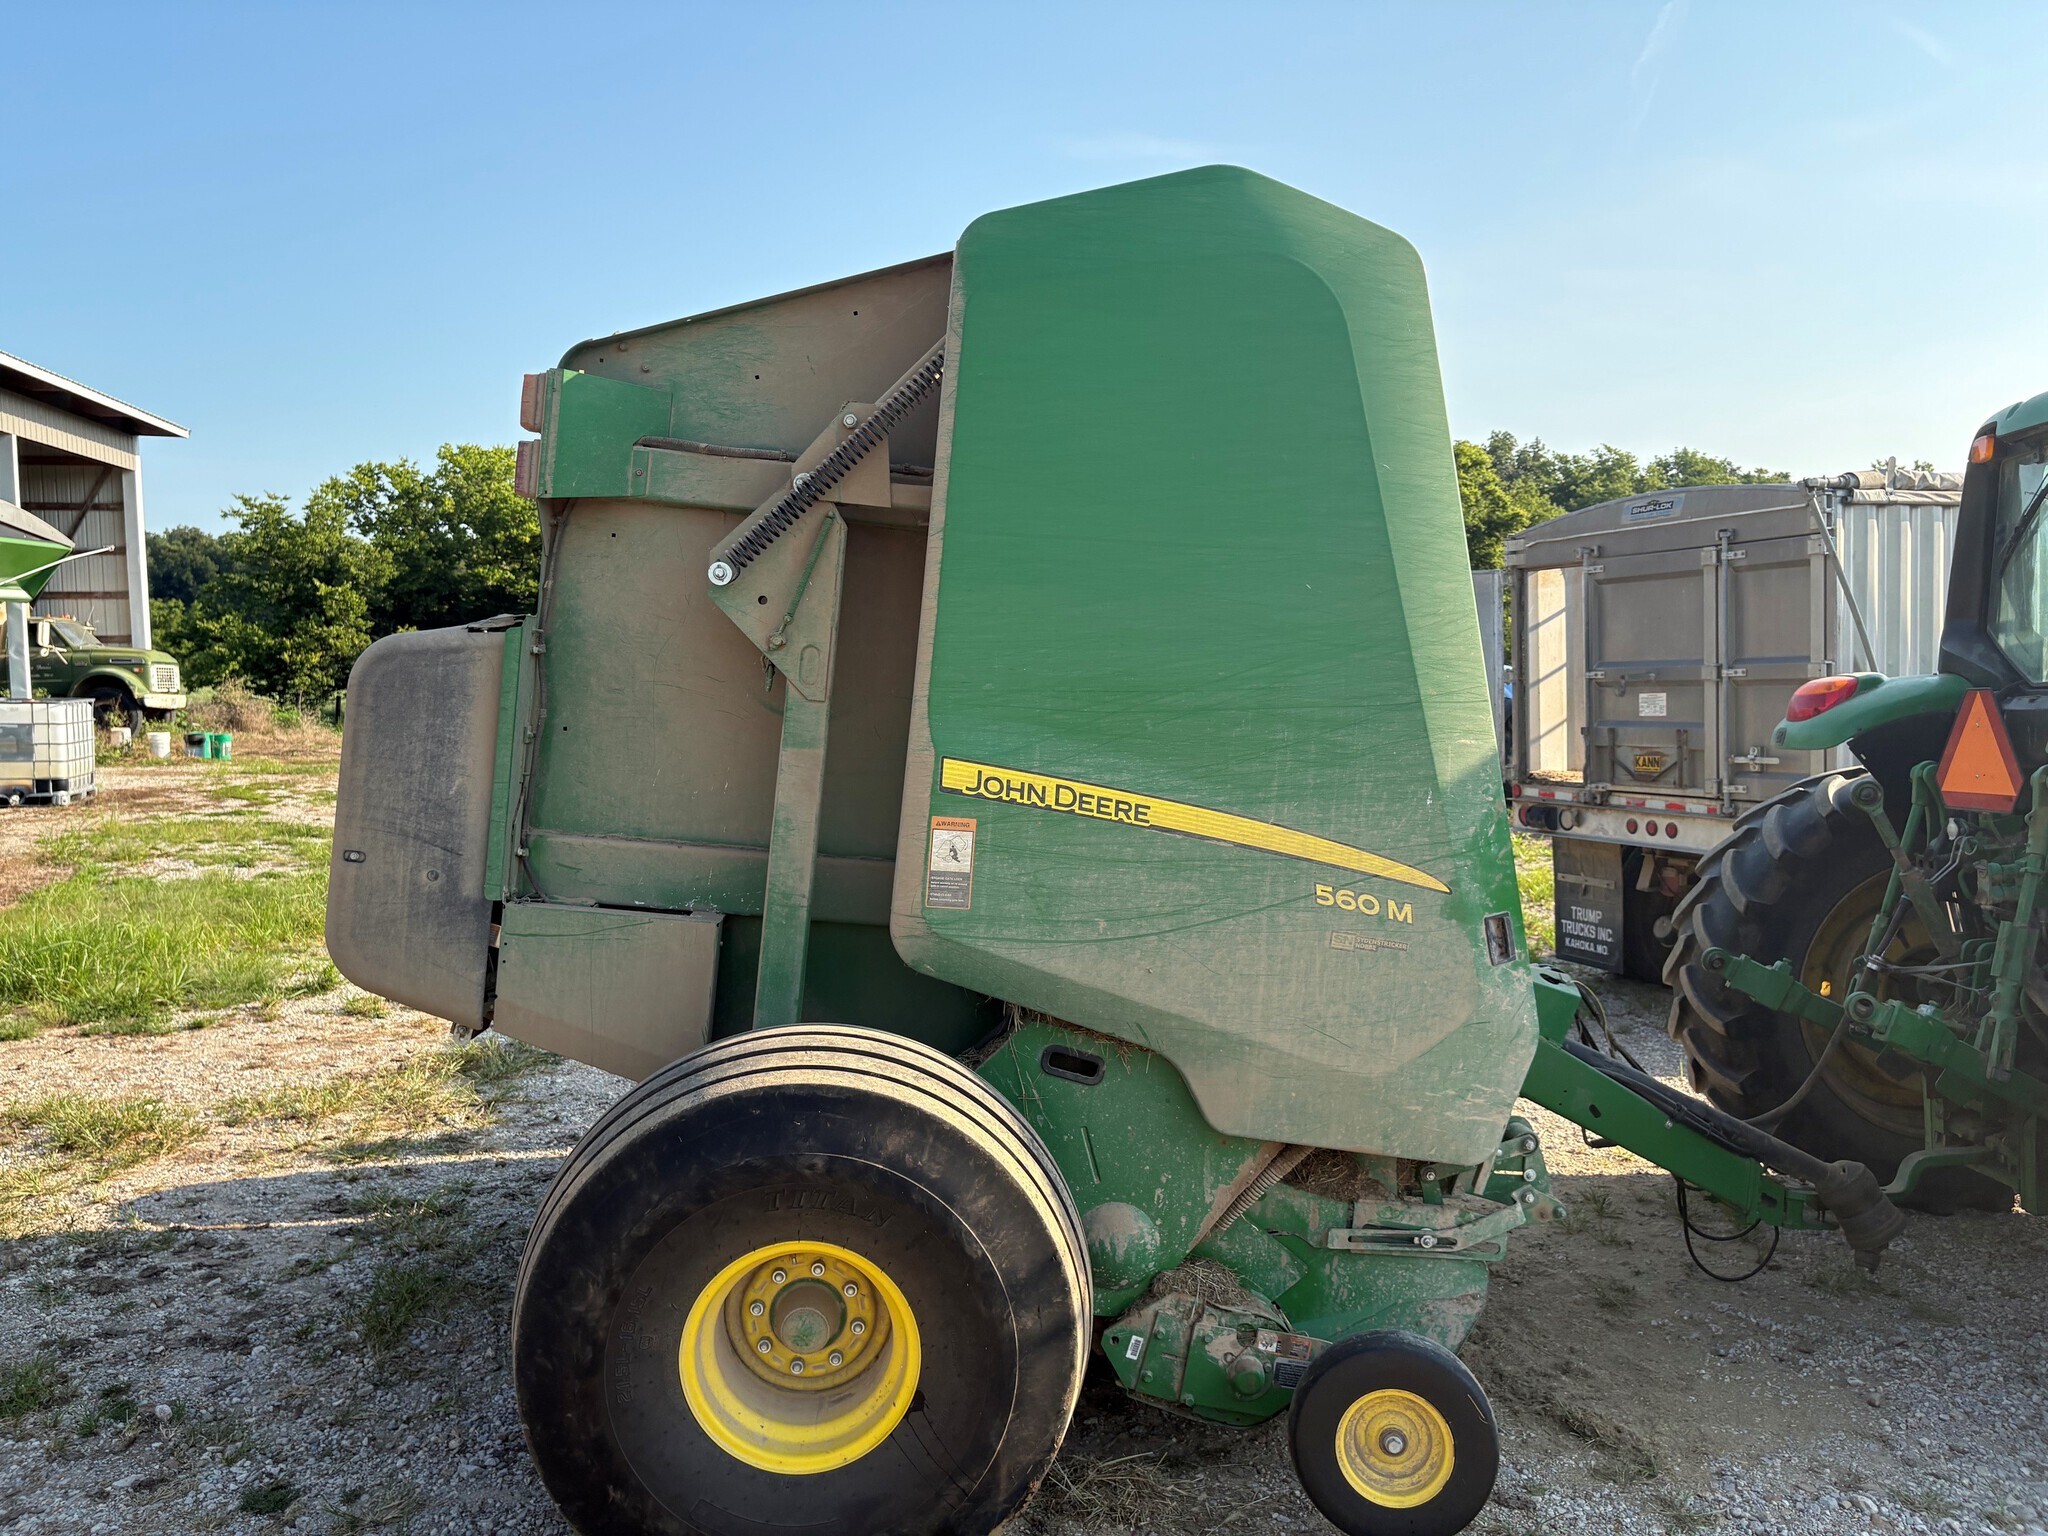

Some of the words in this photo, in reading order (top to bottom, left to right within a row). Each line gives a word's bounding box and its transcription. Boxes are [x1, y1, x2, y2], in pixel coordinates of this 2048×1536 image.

[1632, 502, 1673, 514] SHUR-LOK
[1635, 756, 1660, 767] KANN
[965, 769, 1047, 804] JOHN
[1055, 784, 1151, 824] DEERE
[1315, 884, 1380, 916] 560
[1387, 899, 1413, 925] M
[1571, 906, 1602, 923] TRUMP
[1561, 919, 1596, 938] TRUCKS
[1597, 927, 1614, 942] INC.
[762, 1188, 896, 1228] TITAN
